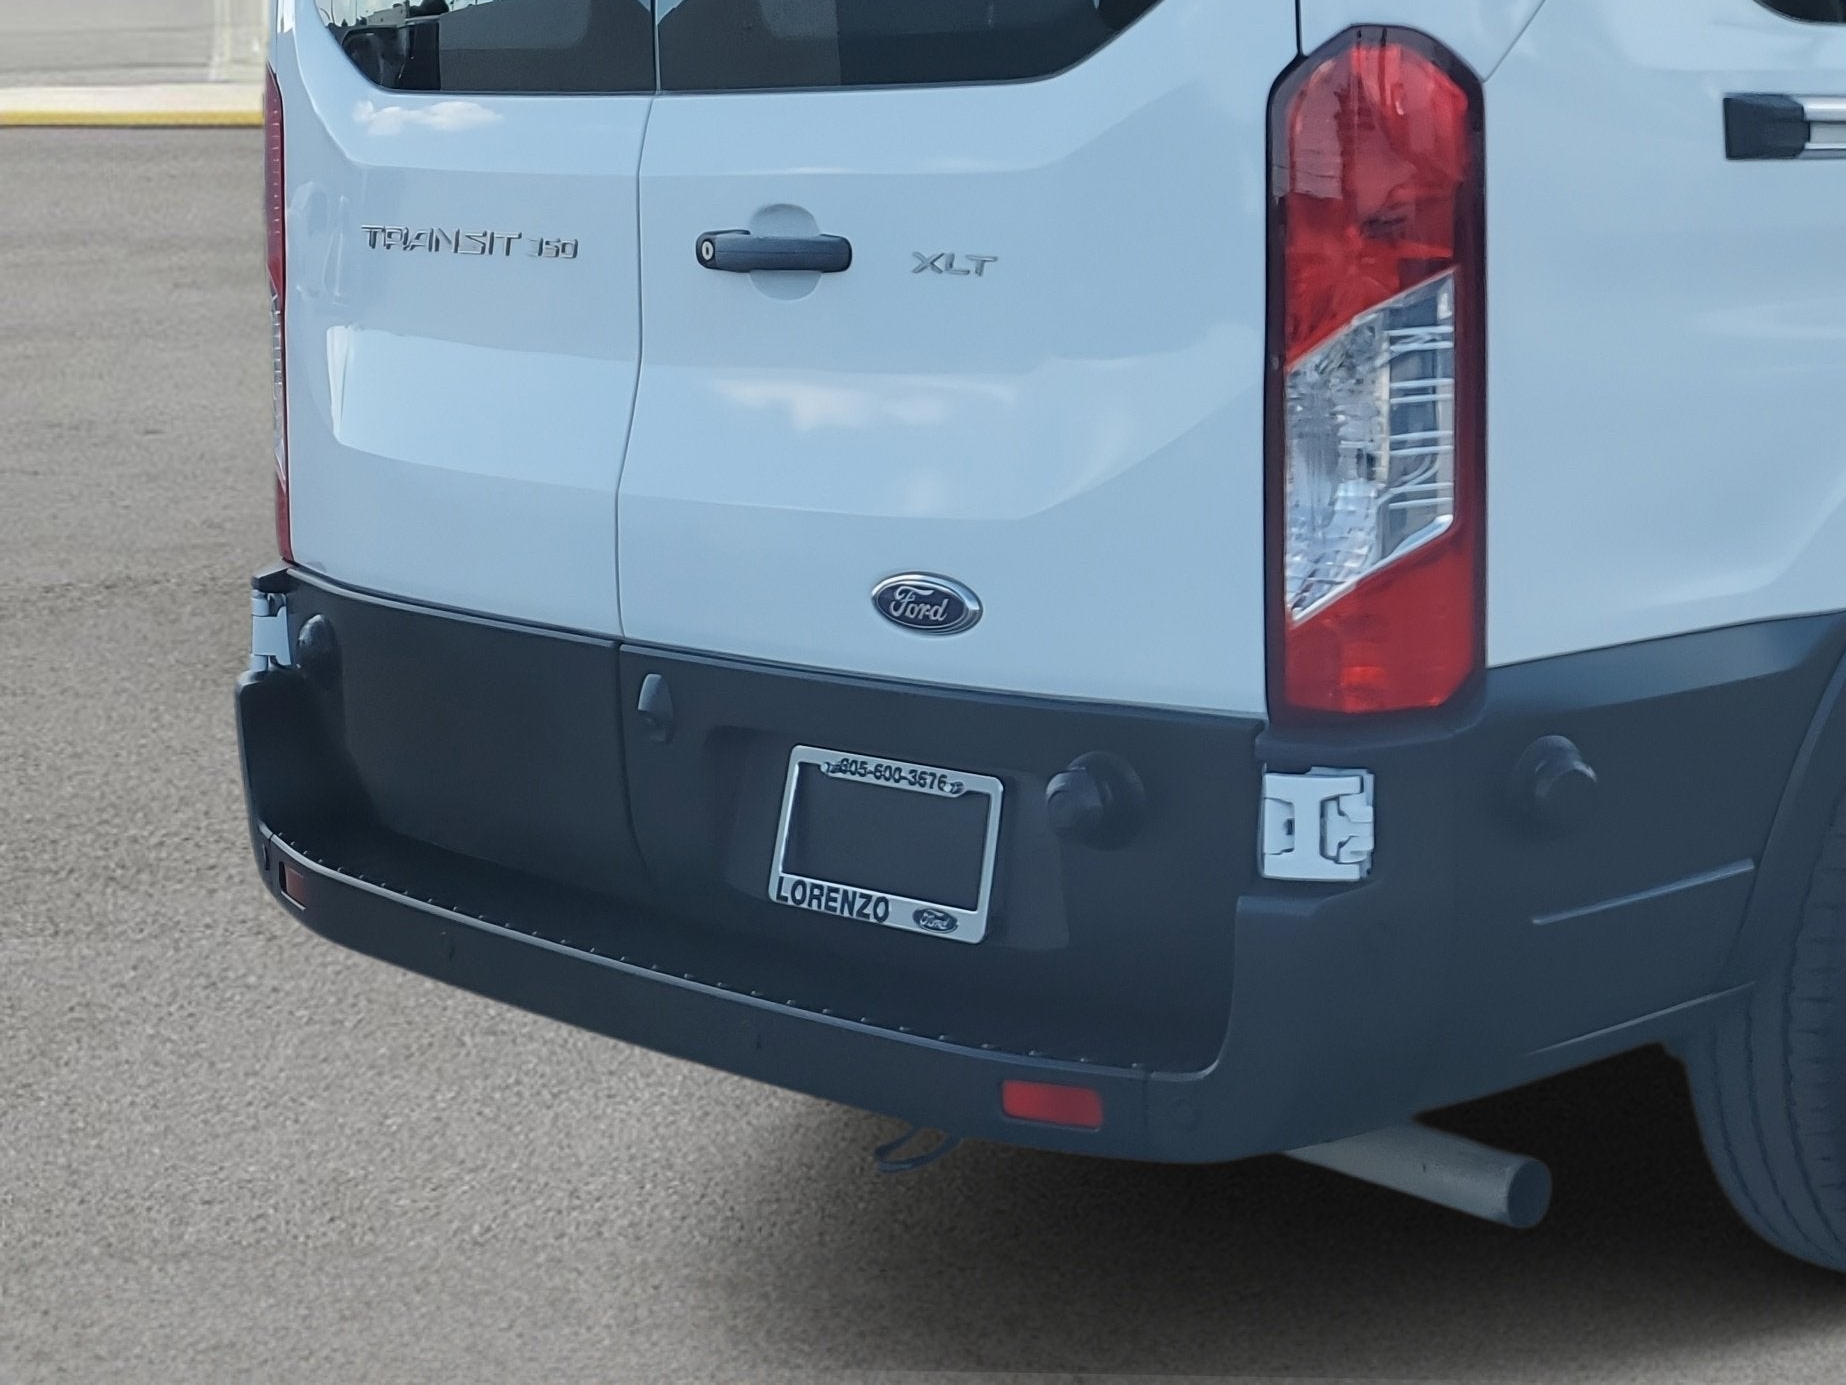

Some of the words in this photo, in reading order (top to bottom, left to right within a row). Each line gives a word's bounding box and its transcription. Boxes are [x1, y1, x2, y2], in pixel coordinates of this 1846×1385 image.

[360, 224, 523, 258] TRANSIT
[525, 237, 580, 260] 350
[911, 250, 999, 277] XLT
[889, 585, 950, 622] Ford
[776, 876, 890, 924] LORENZO
[918, 908, 951, 931] Ford
